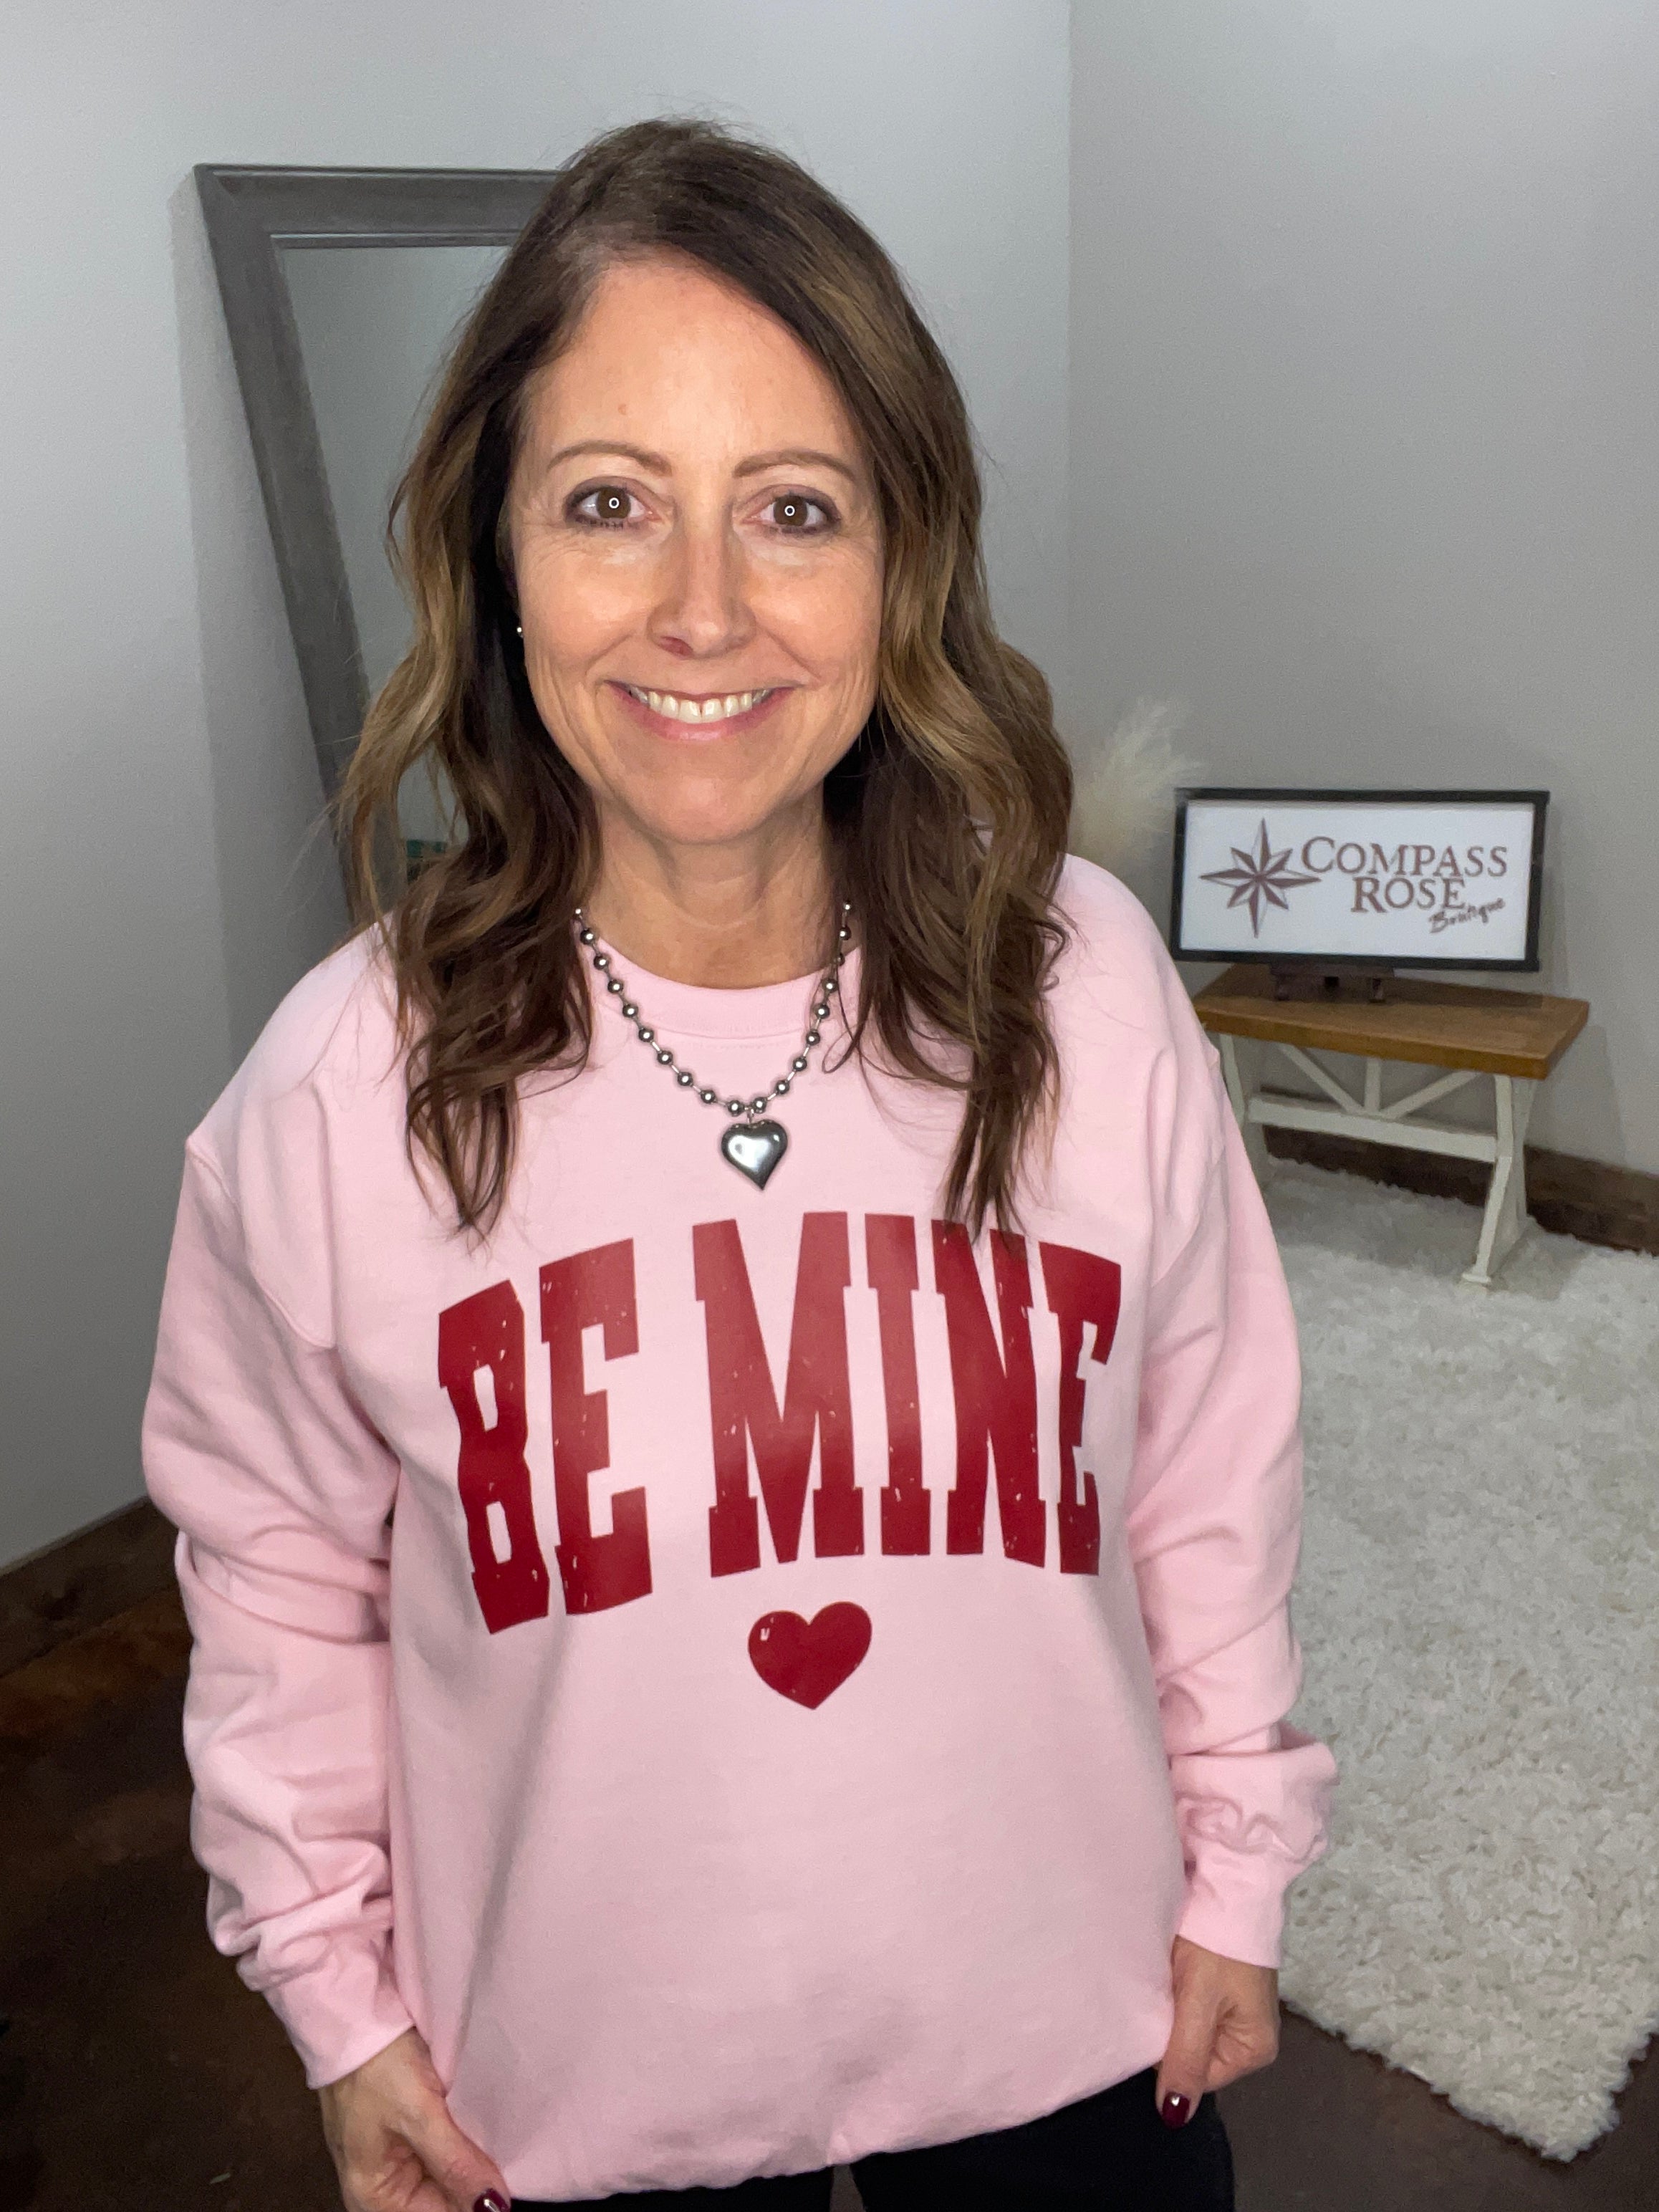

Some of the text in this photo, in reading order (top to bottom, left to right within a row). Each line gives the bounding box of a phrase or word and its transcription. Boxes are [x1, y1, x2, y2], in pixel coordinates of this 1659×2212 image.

[1302, 836, 1508, 877] COMPASS
[1350, 877, 1466, 913] ROSE
[438, 1211, 1122, 1635] BE MINE
